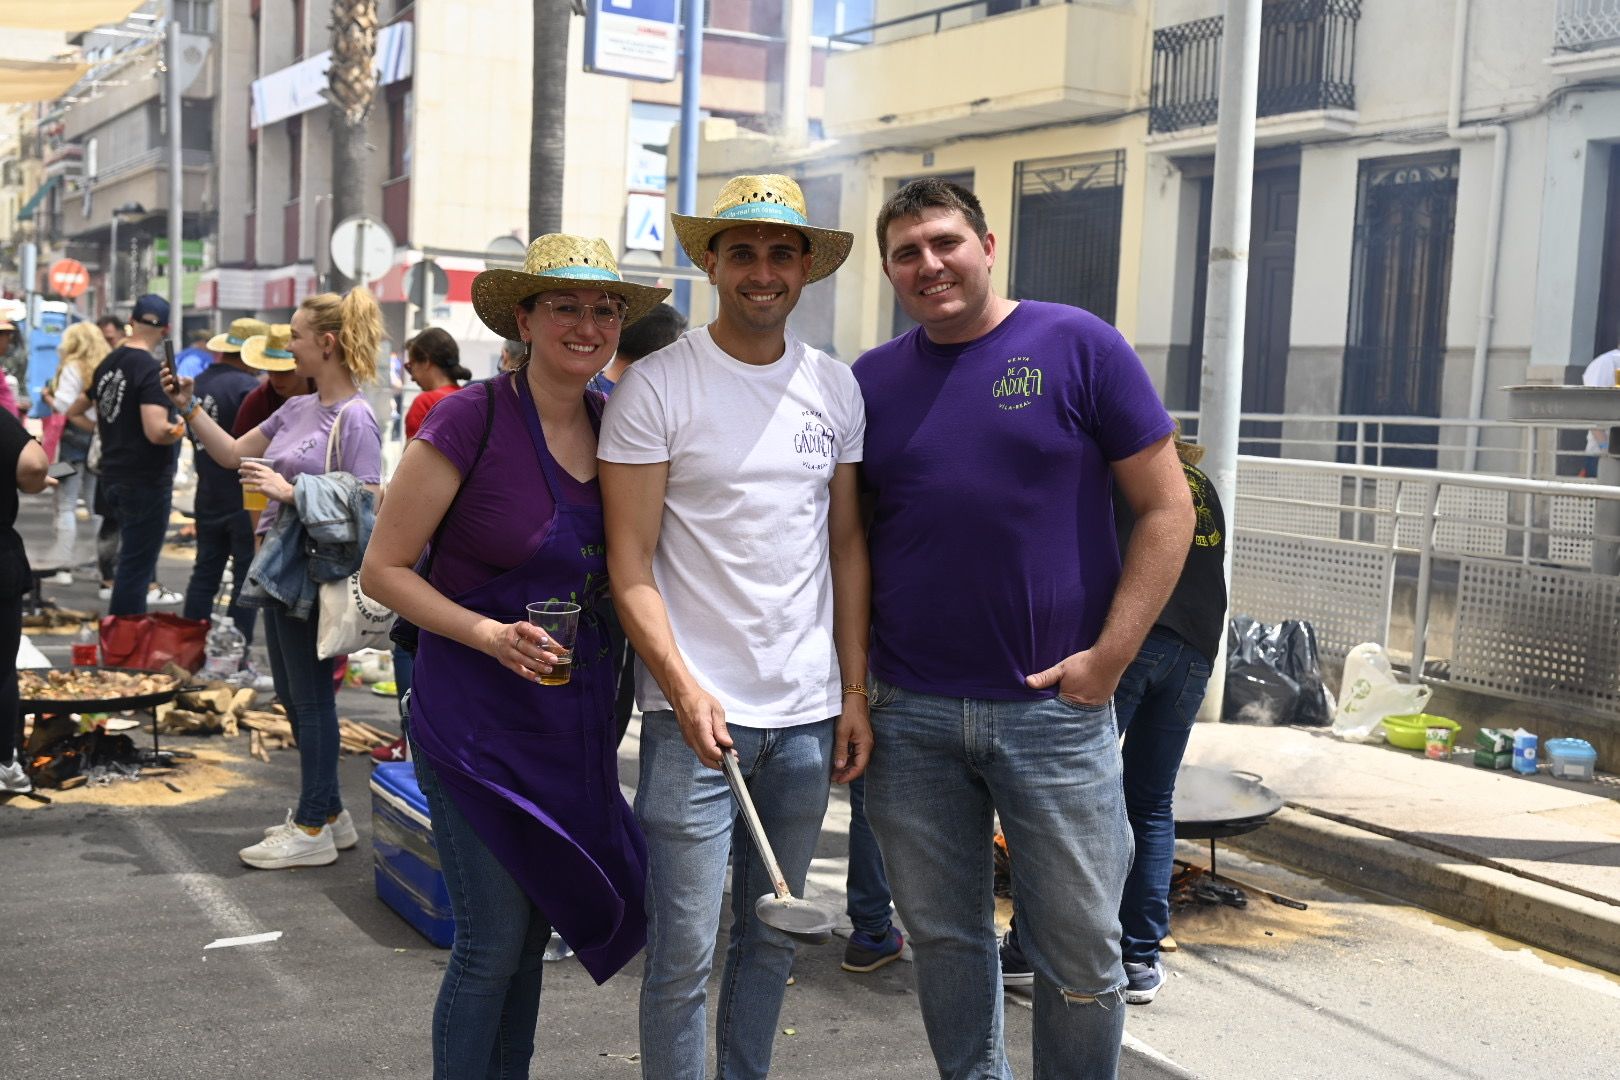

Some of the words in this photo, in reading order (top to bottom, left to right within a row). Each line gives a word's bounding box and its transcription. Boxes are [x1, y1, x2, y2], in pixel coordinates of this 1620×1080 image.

[1007, 367, 1016, 377] DE
[999, 400, 1032, 411] VILA-REAL
[805, 421, 813, 431] DE
[580, 544, 605, 559] PEN
